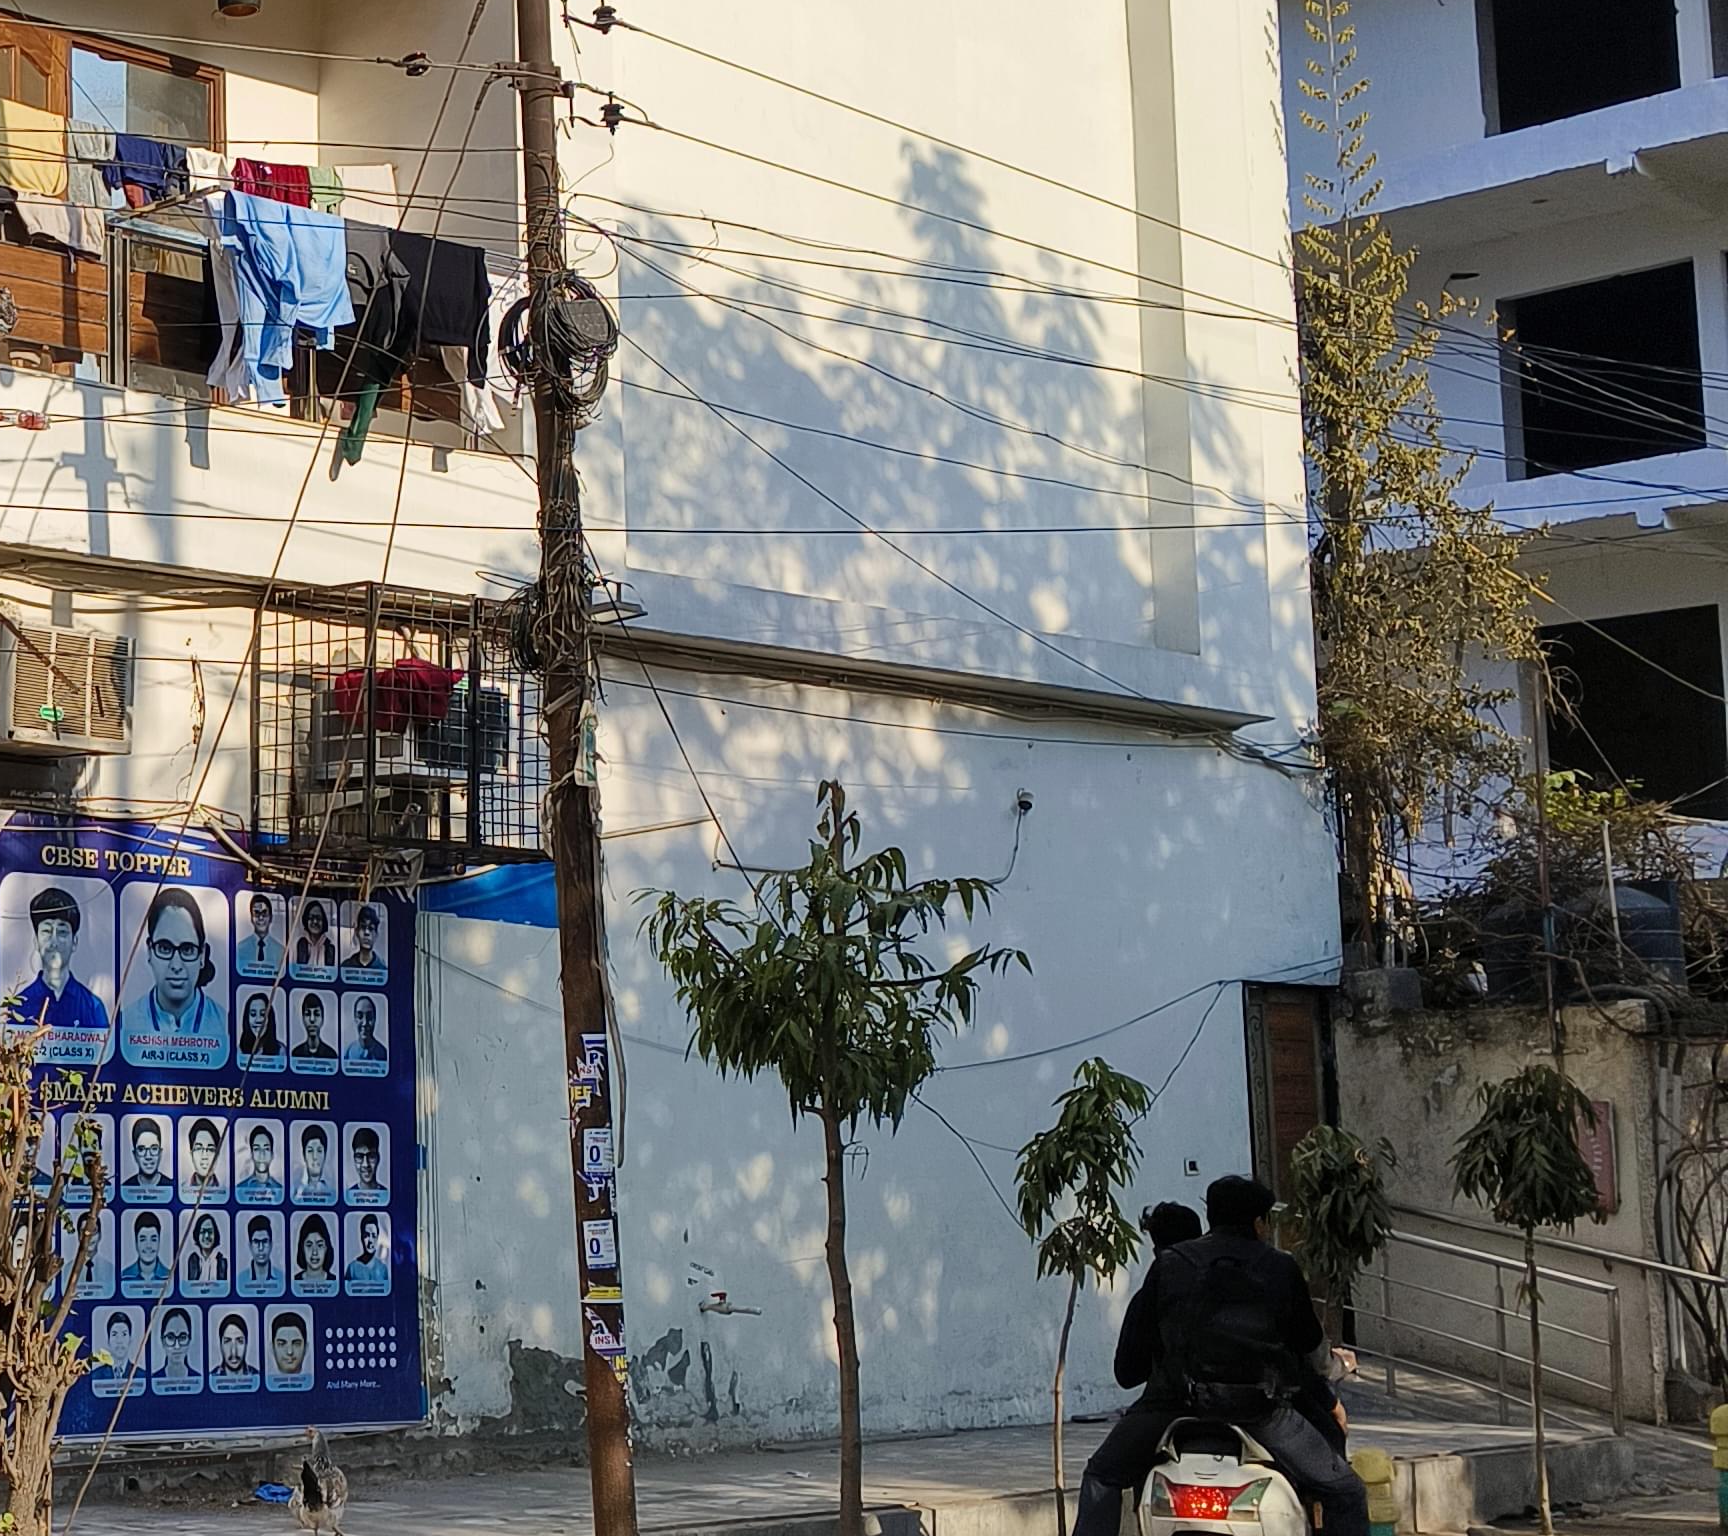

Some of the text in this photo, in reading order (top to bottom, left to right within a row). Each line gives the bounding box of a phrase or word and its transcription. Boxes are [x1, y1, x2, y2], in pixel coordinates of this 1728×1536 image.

[41, 845, 193, 877] CBSE TOPPER
[39, 1082, 331, 1111] SMART ACHIEVERS ALUMNI
